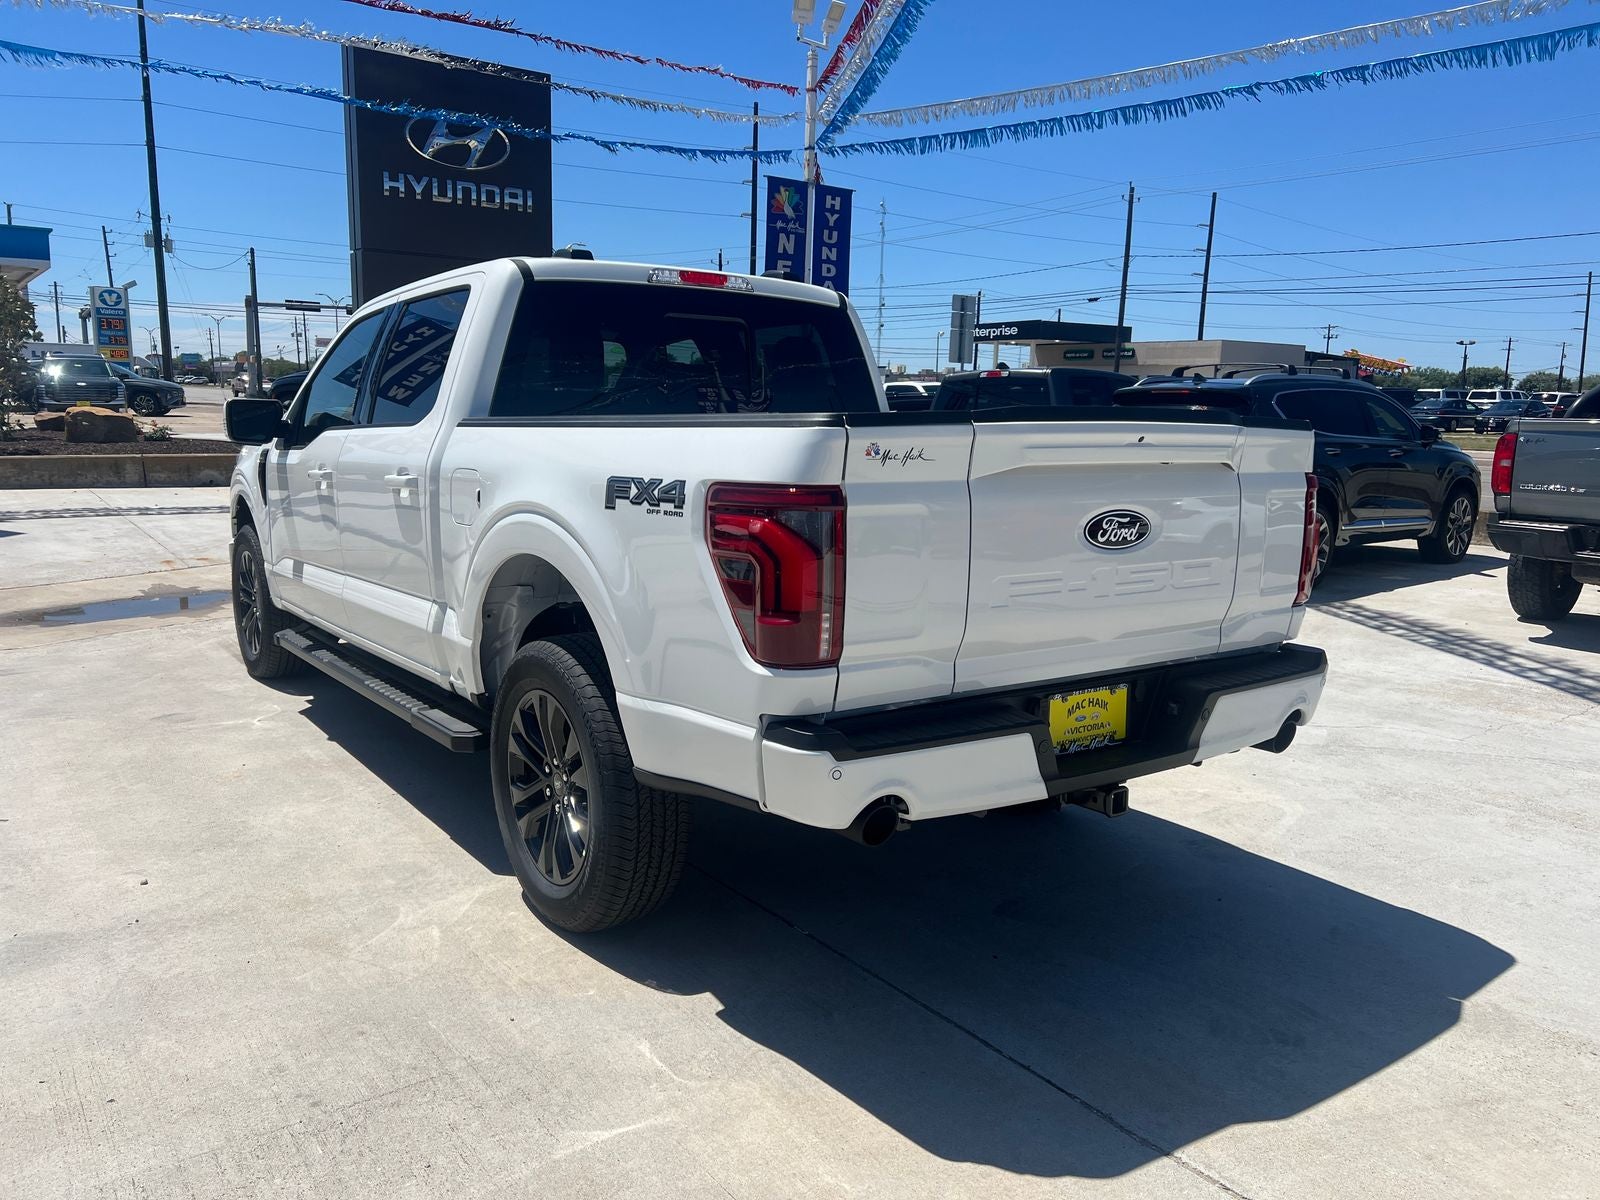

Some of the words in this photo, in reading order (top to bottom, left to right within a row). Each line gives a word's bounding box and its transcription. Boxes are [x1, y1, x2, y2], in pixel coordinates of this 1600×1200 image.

[382, 170, 533, 213] HYUNDAI
[820, 194, 841, 291] HYUNDA
[879, 448, 900, 467] Mac
[900, 447, 932, 467] Haik
[605, 476, 686, 510] FX4
[663, 510, 684, 518] ROAD
[1097, 516, 1145, 543] Ford
[1067, 699, 1087, 720] MAC
[1088, 697, 1109, 712] HAIK
[1070, 722, 1105, 735] VICTORIA
